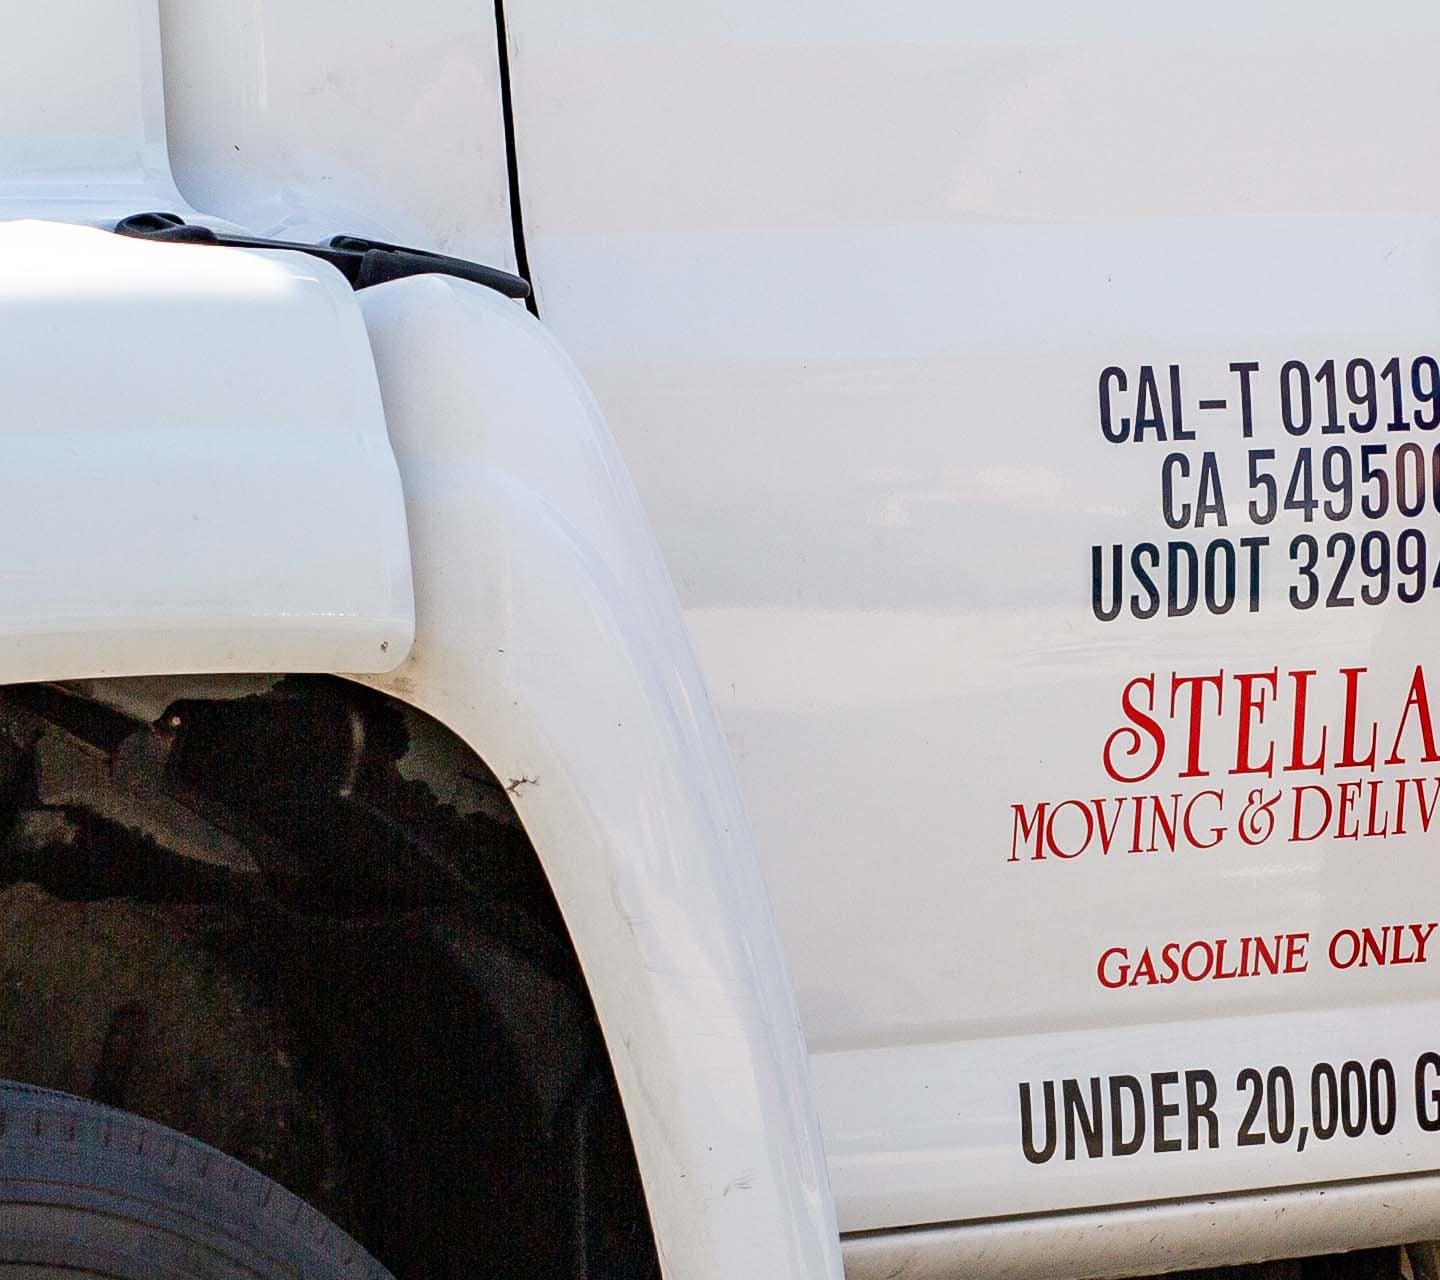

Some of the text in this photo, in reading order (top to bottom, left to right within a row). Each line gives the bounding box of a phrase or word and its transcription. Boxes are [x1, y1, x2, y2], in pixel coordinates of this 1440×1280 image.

[1098, 360, 1261, 444] CAL-T
[1161, 451, 1229, 530] CA
[1091, 536, 1271, 622] USDOT
[1006, 790, 1227, 862] MOVING
[1237, 789, 1283, 847] &
[1096, 922, 1439, 990] GASOLINE ONLY
[1018, 1069, 1221, 1165] UNDER
[1235, 1057, 1398, 1154] 20,000
